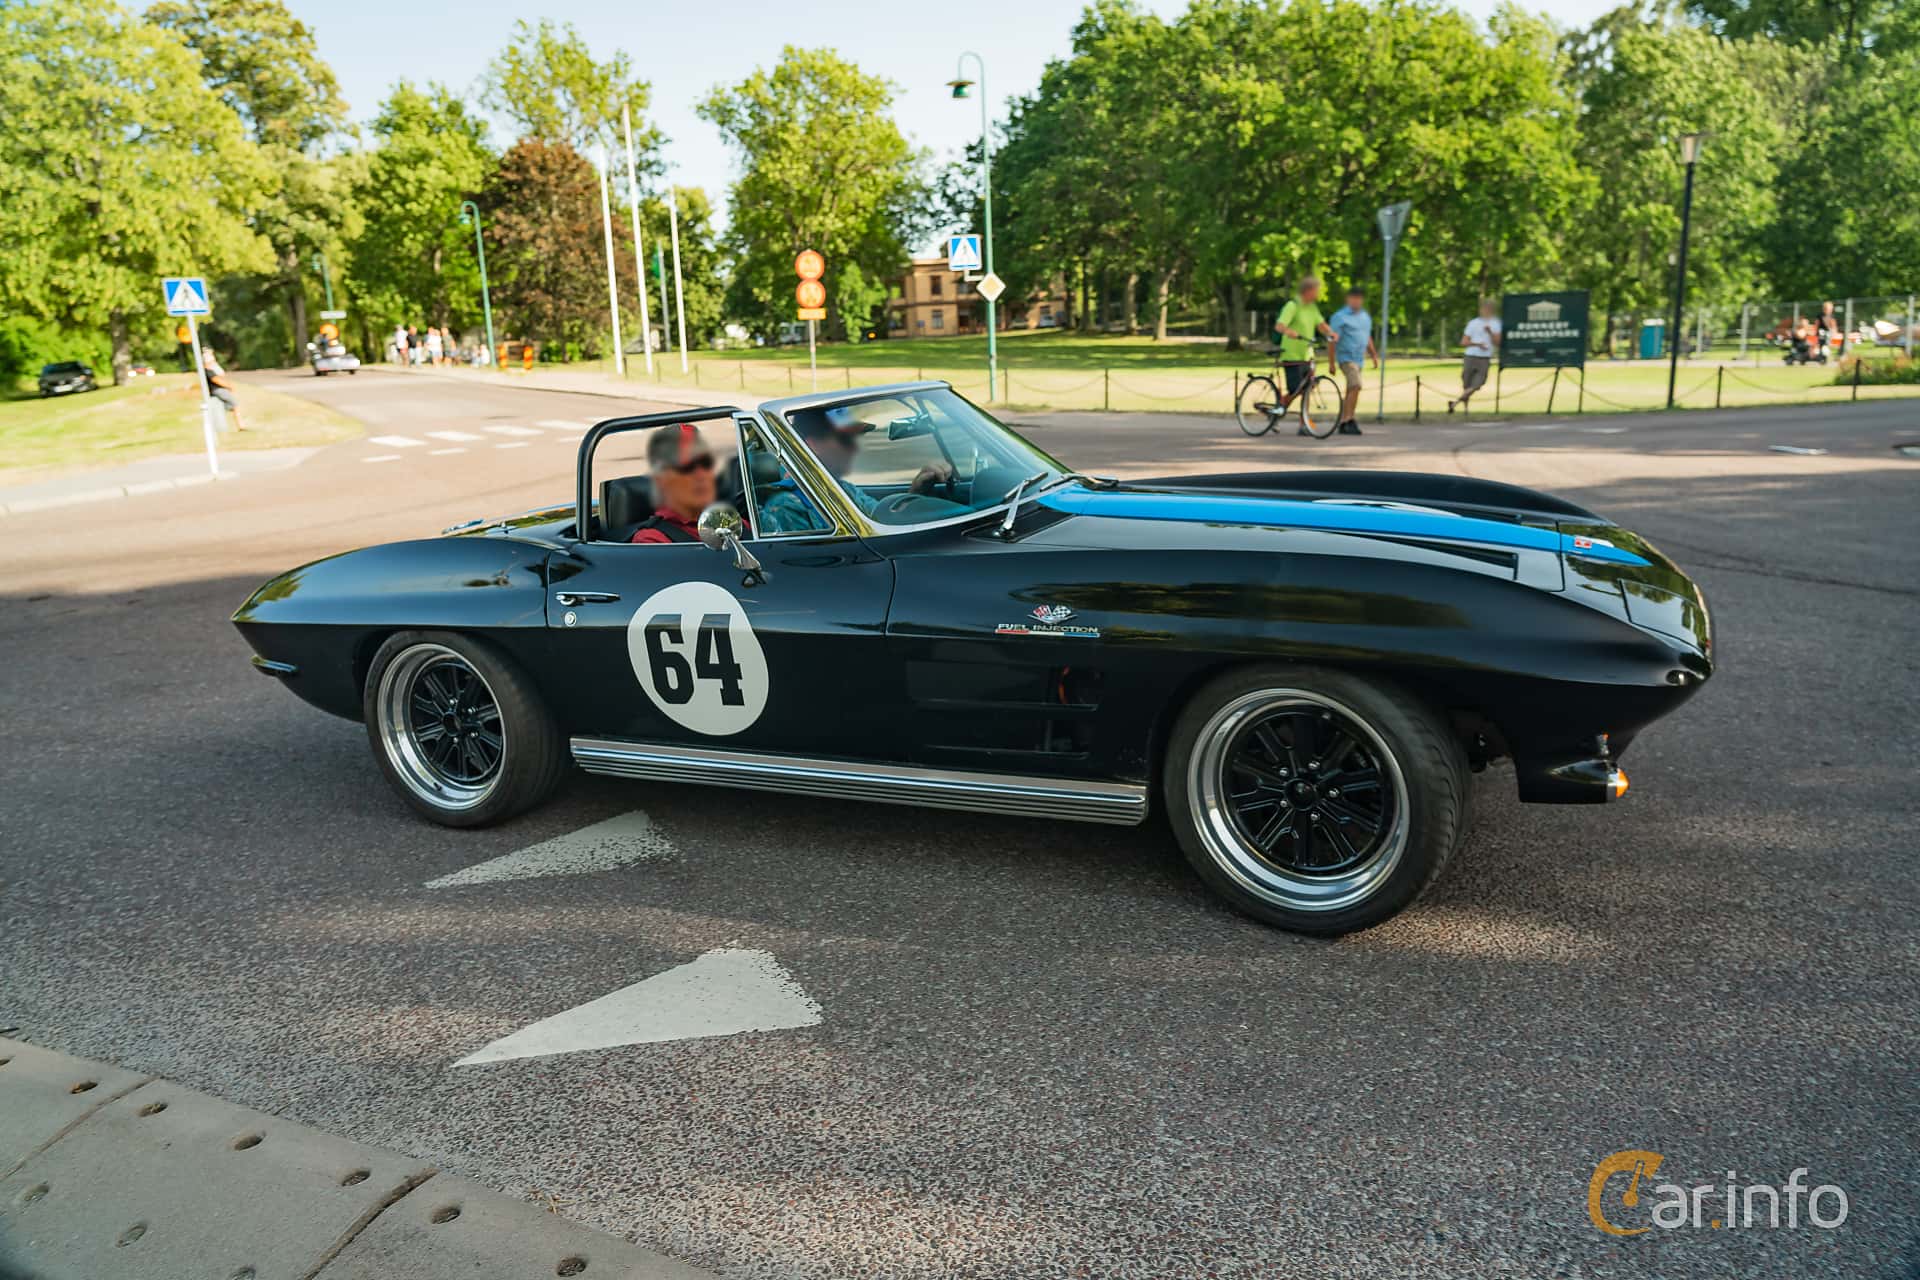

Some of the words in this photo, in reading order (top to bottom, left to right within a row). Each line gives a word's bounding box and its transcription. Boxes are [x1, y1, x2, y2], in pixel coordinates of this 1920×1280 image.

[998, 623, 1029, 631] FUEL
[1032, 624, 1098, 633] INJECTION
[645, 613, 745, 706] 64
